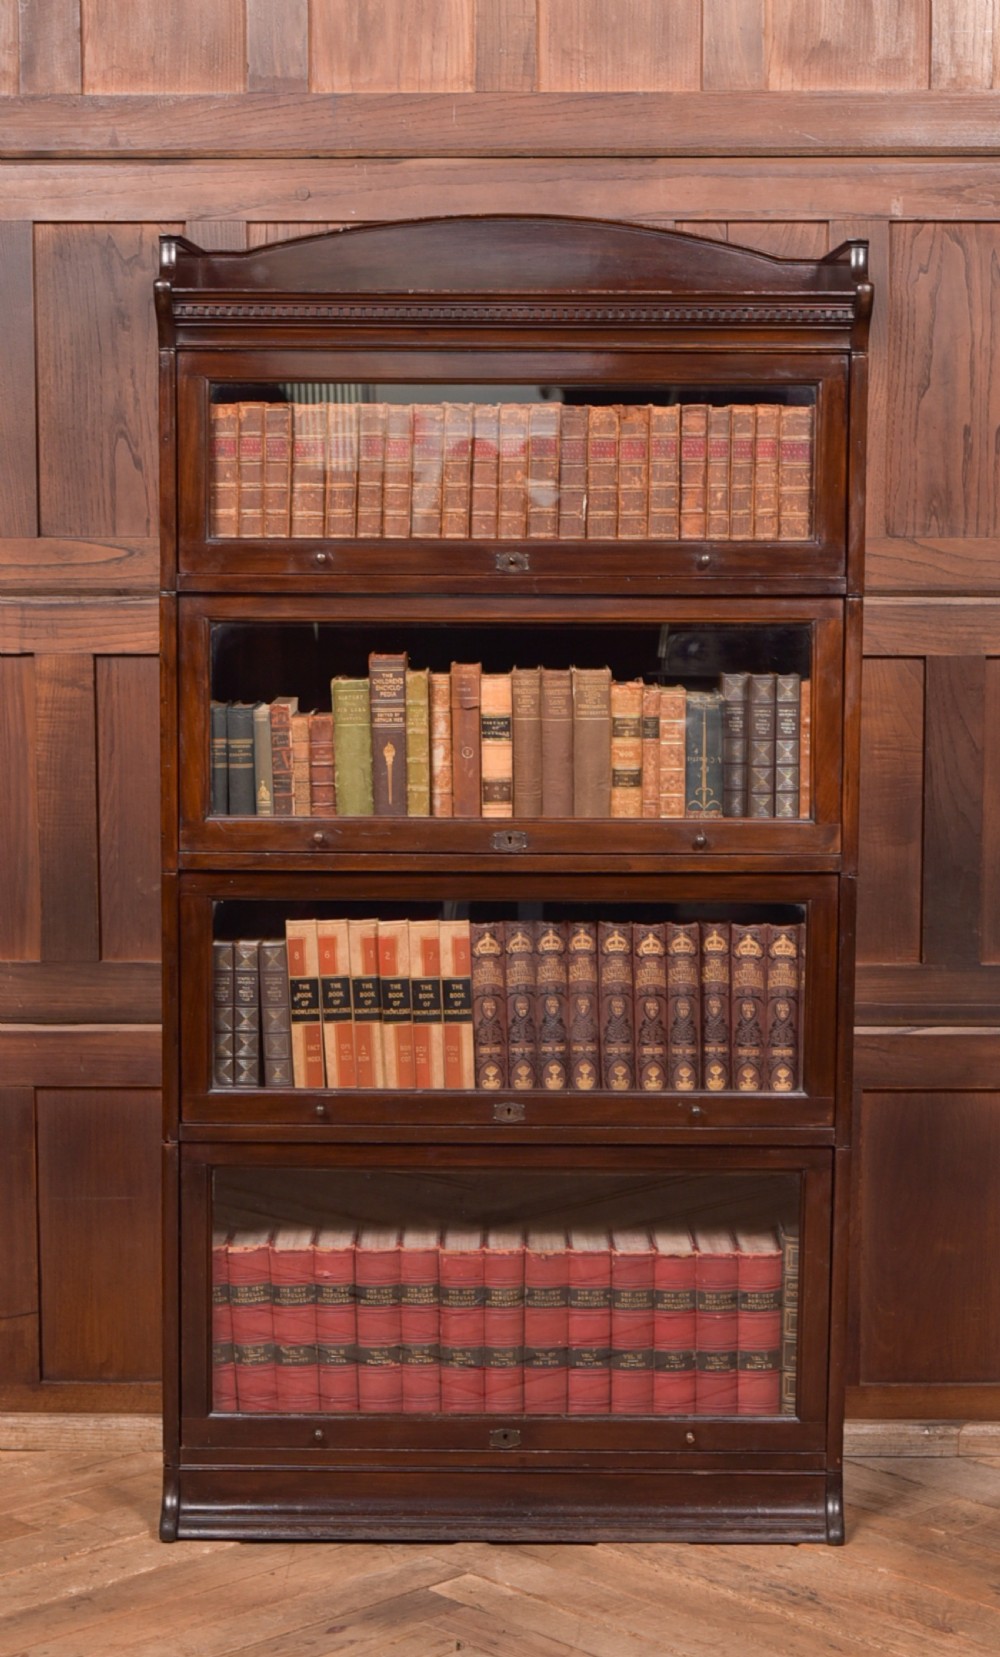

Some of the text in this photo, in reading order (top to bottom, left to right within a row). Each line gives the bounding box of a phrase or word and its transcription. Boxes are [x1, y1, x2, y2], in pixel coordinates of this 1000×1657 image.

[294, 951, 300, 960] 8
[324, 950, 331, 959] 6
[369, 950, 374, 959] 1
[385, 952, 391, 960] 2
[428, 952, 434, 961] 7
[459, 952, 465, 960] 3
